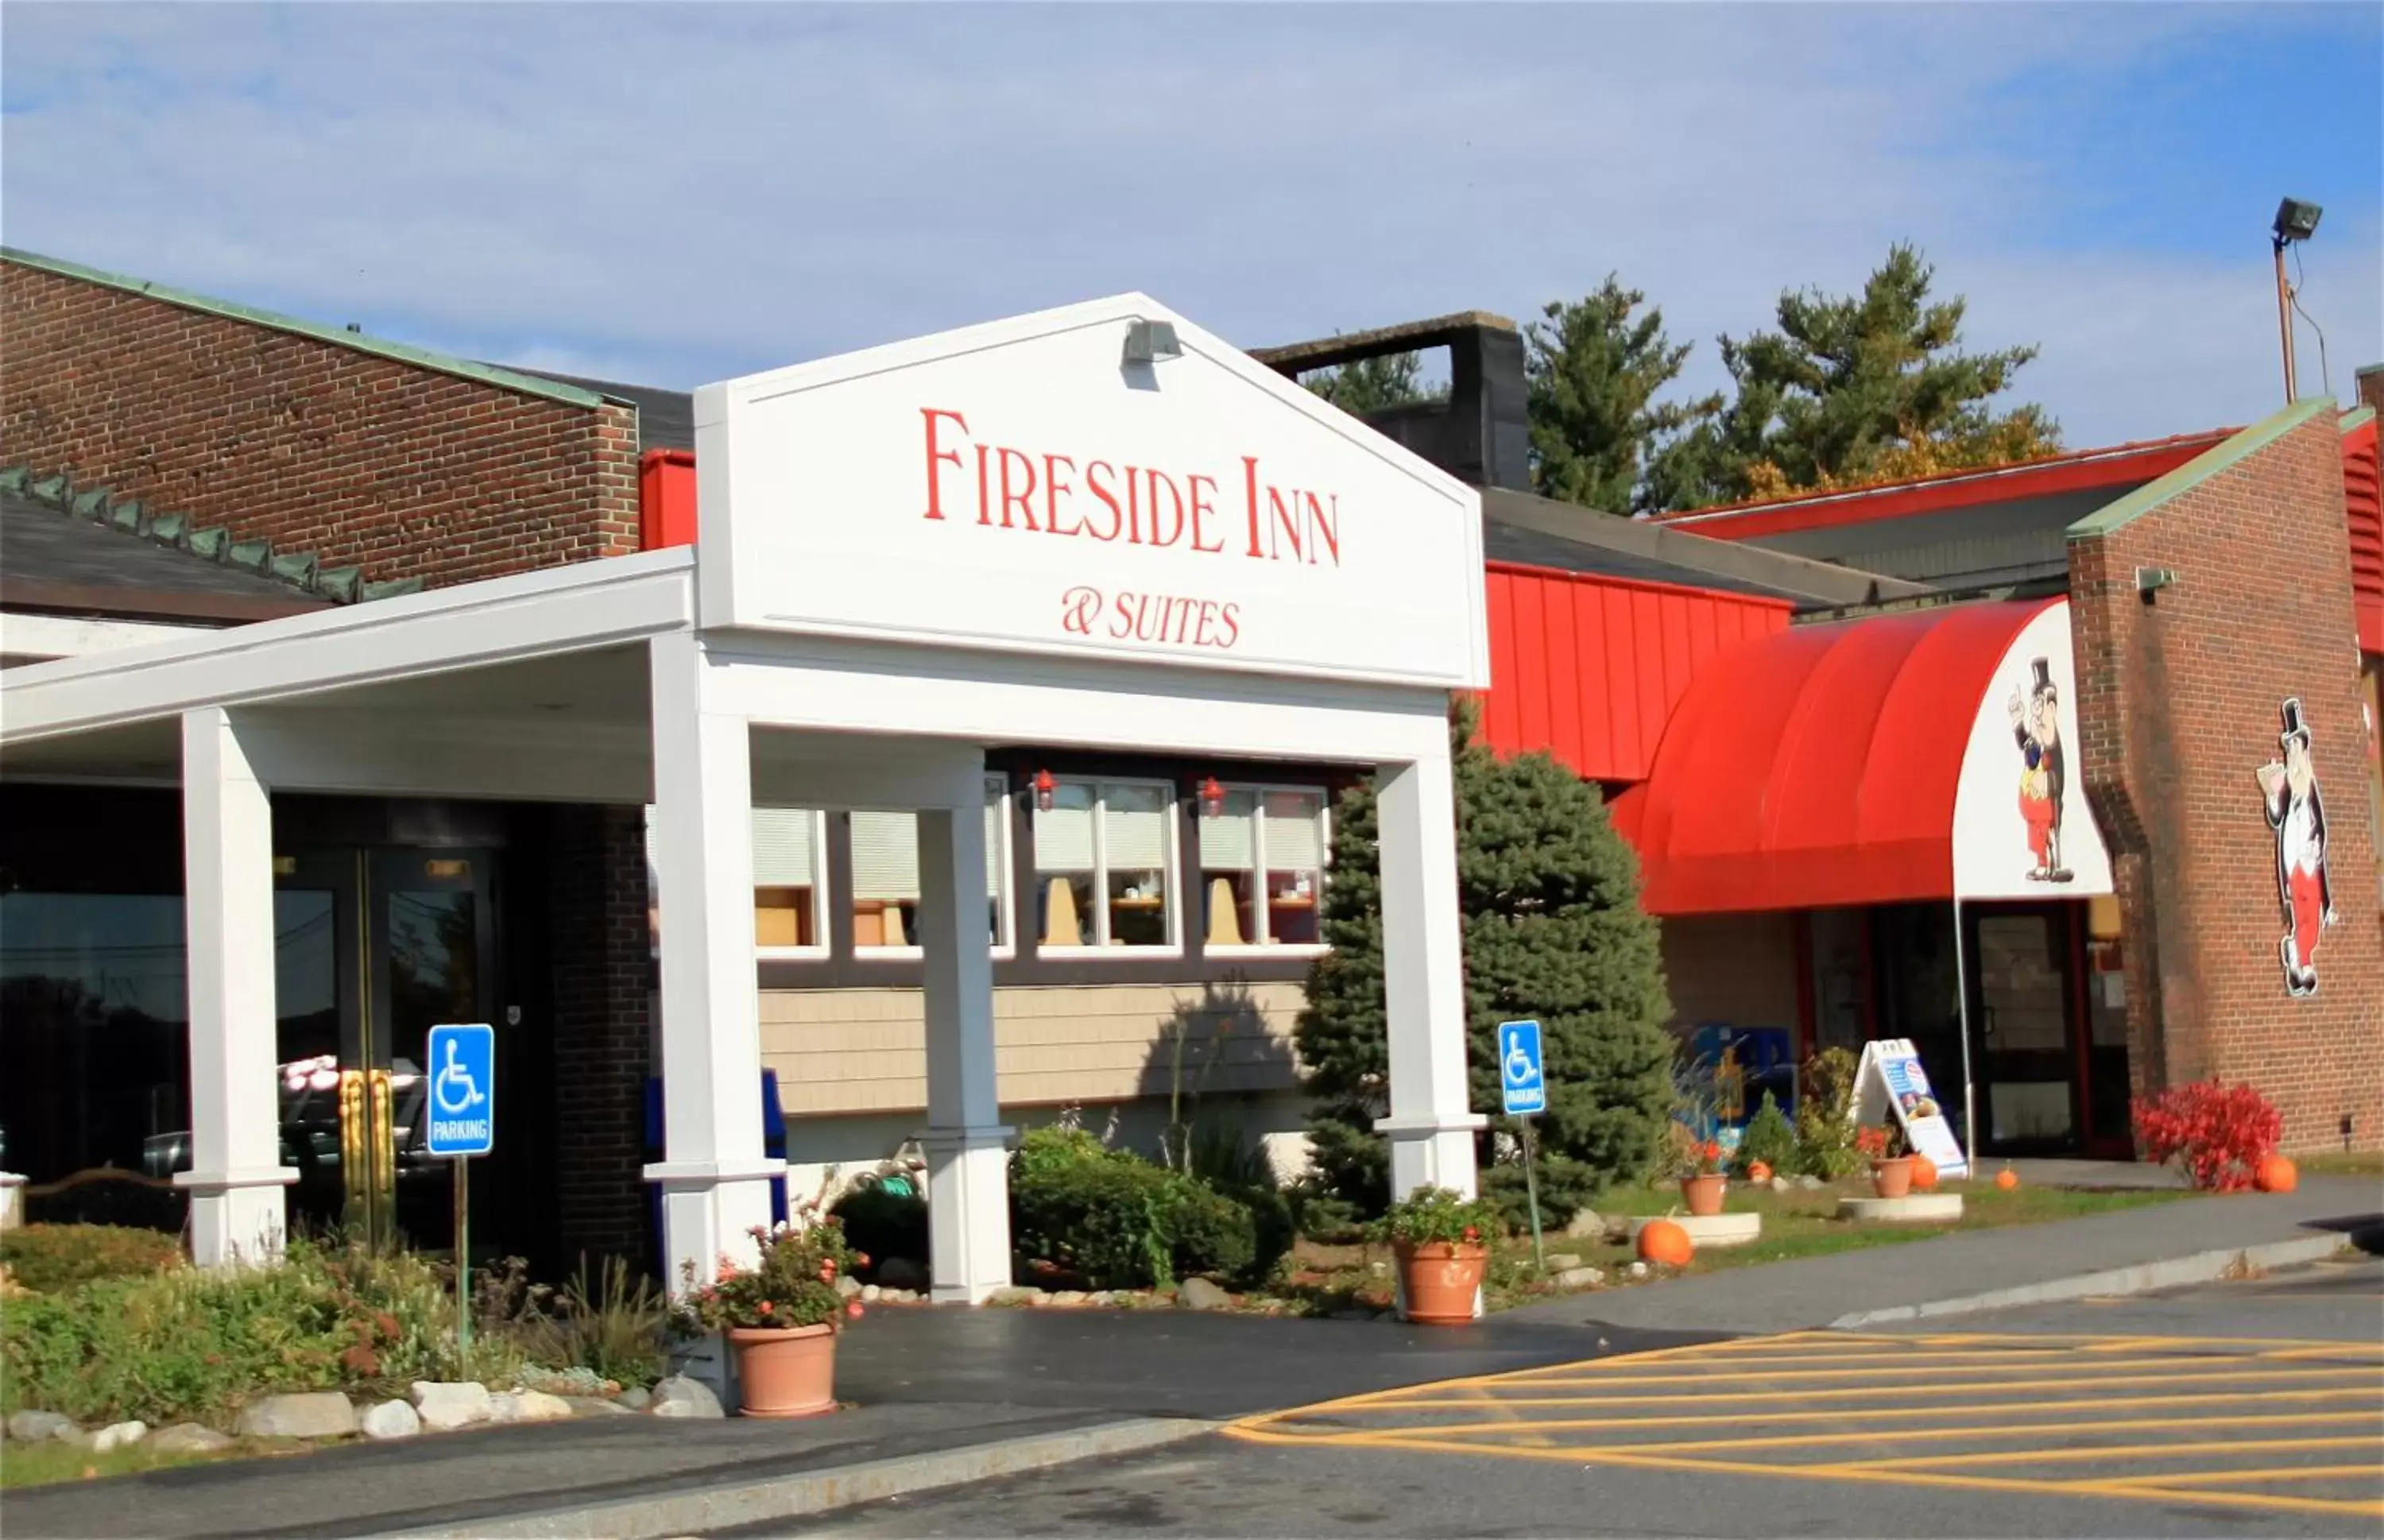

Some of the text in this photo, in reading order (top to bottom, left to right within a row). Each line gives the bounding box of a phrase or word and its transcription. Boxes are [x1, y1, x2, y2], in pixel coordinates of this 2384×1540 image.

[920, 407, 1340, 567] FIRESIDE INN
[1061, 586, 1240, 649] & SUITES
[433, 1119, 488, 1141] PARKING
